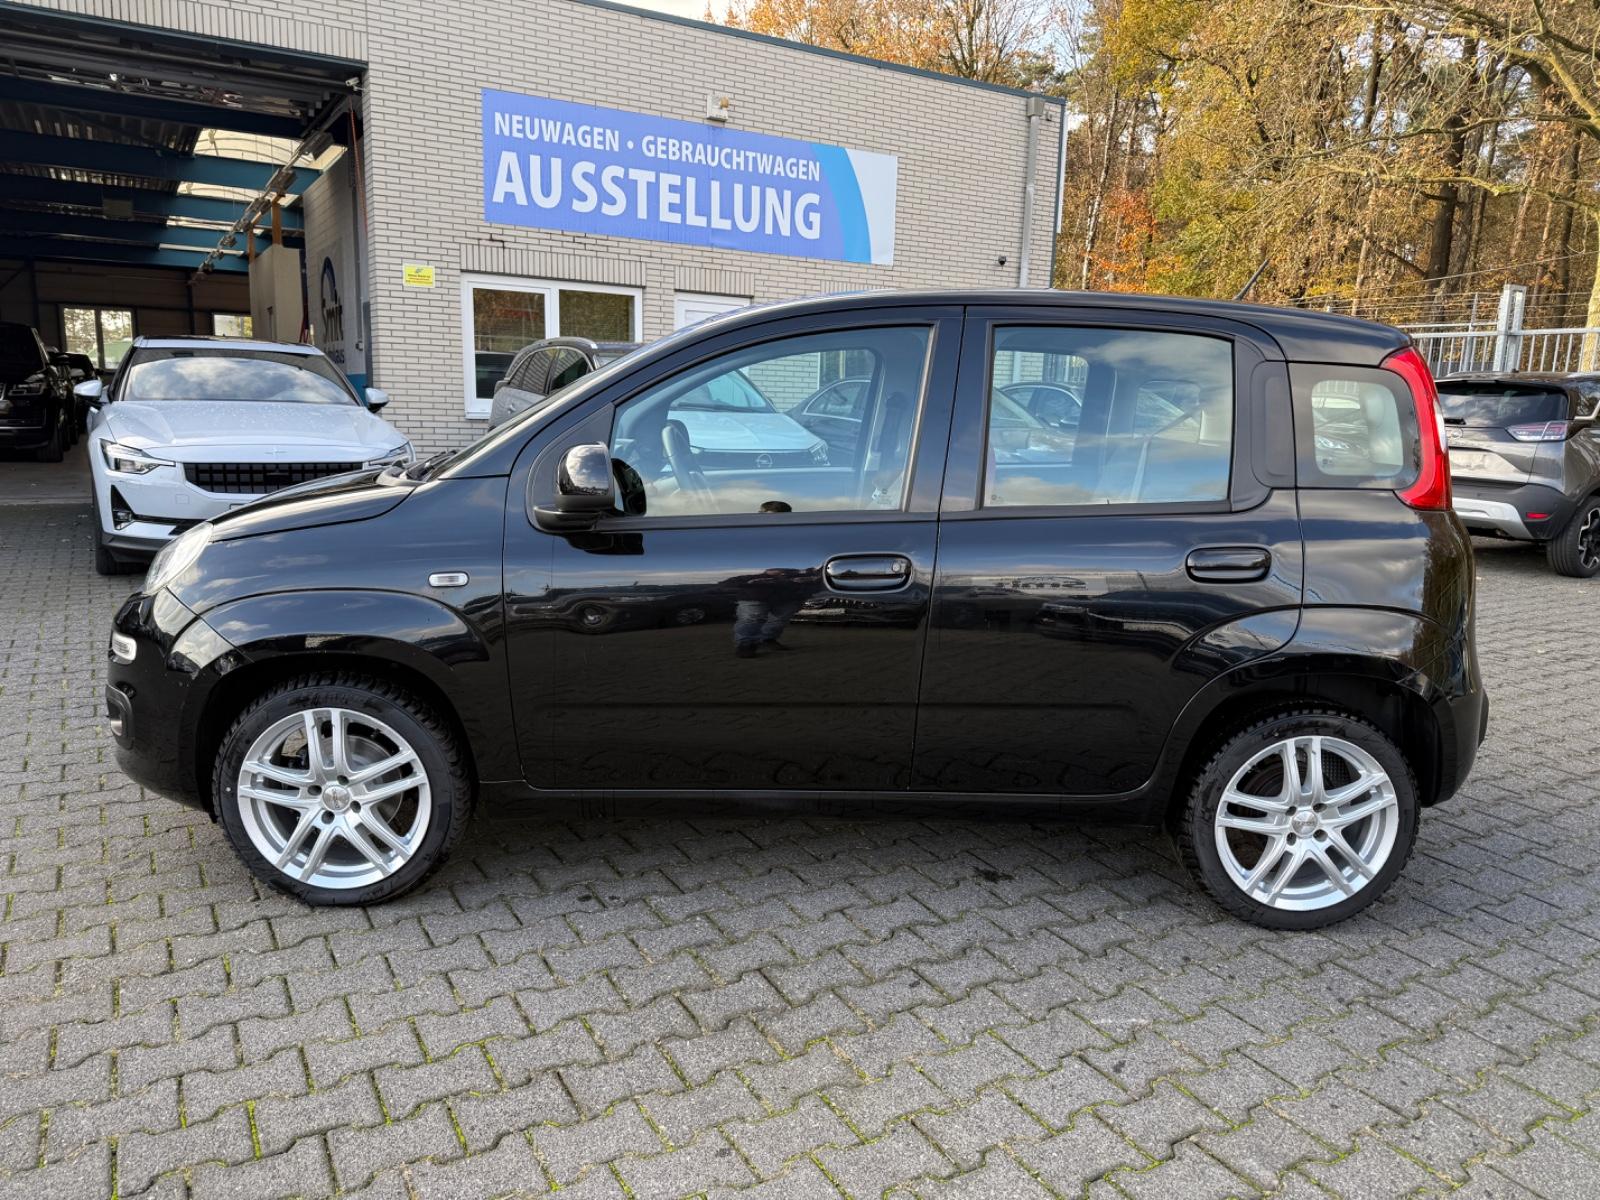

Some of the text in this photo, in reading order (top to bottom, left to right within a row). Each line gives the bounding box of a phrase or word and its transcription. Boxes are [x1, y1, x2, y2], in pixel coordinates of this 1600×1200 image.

[494, 111, 820, 182] NEUWAGEN GEBRAUCHTWAGEN
[492, 150, 821, 240] AUSSTELLUNG
